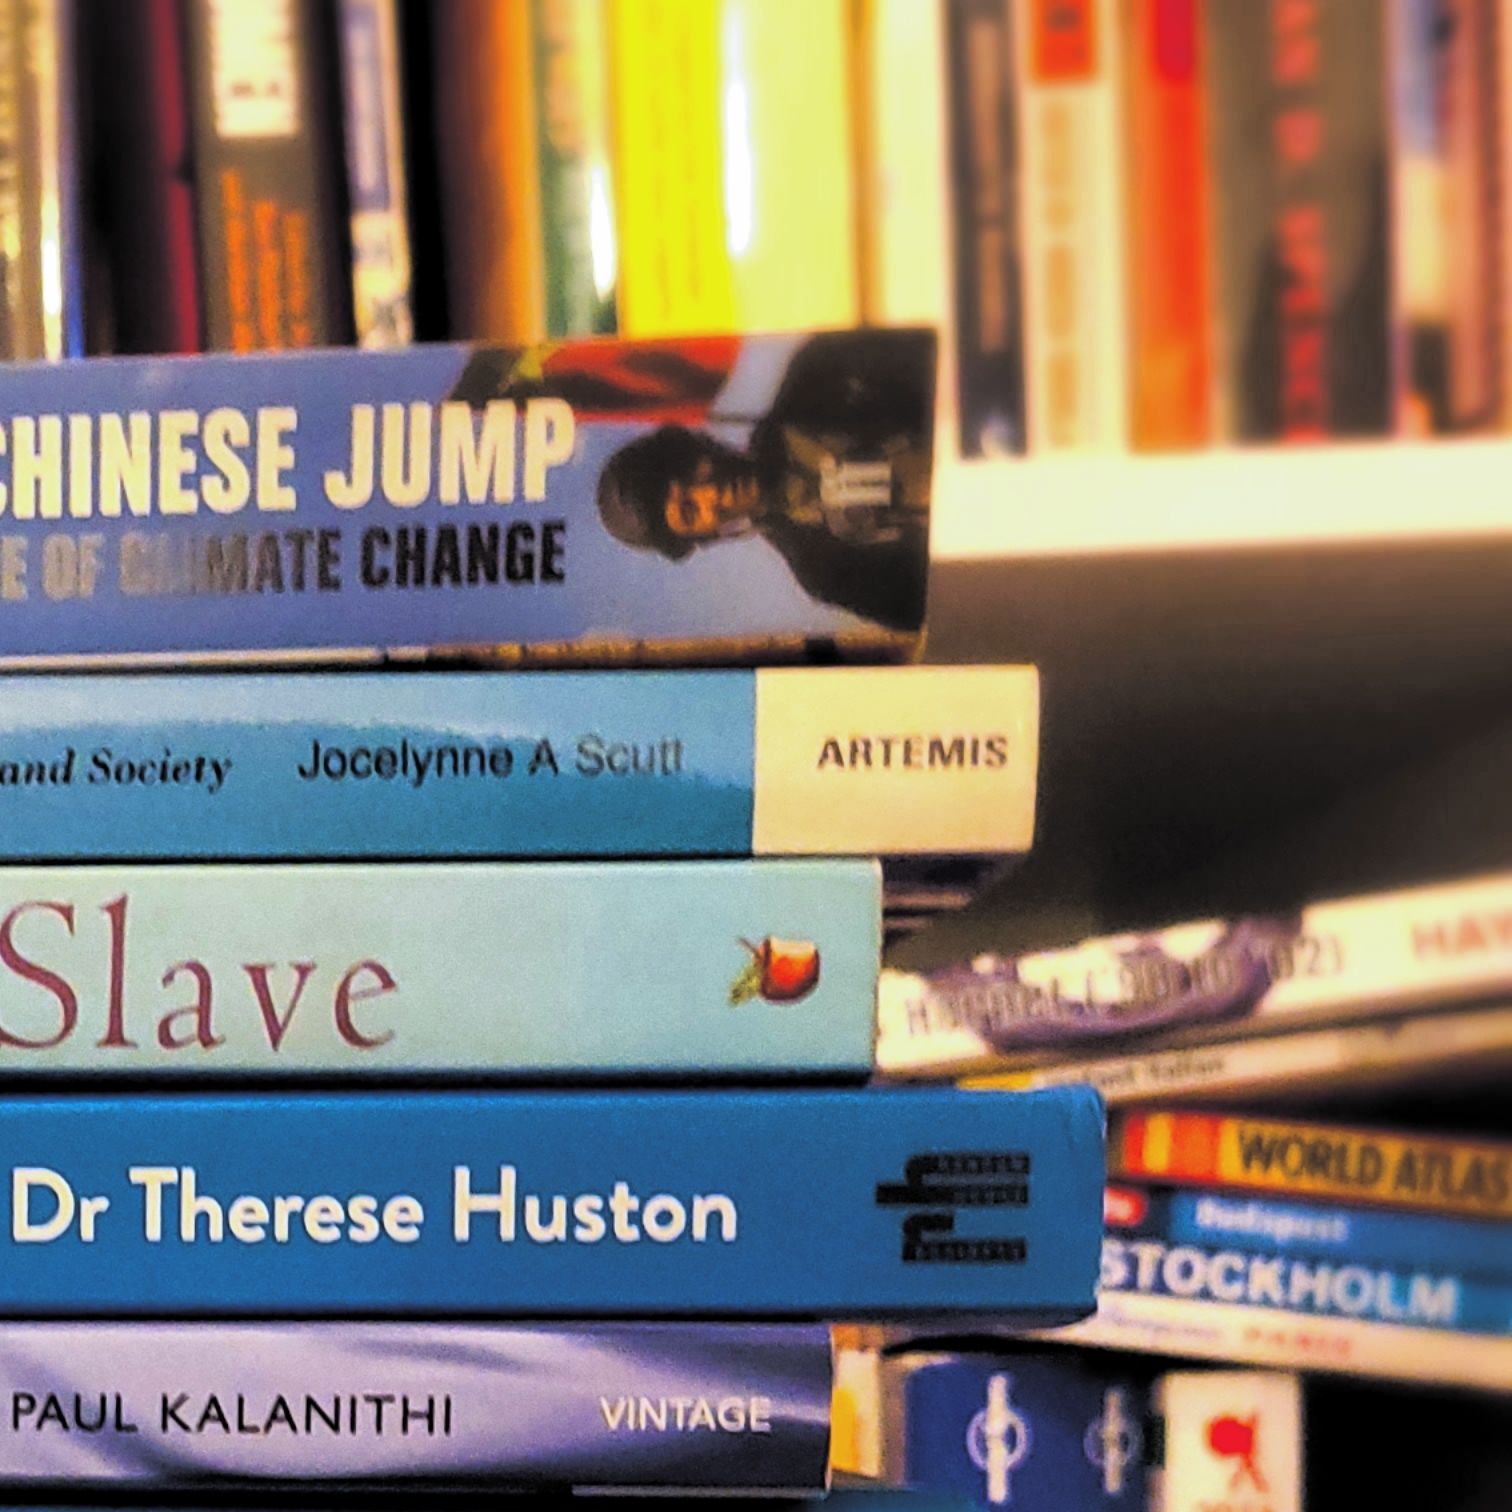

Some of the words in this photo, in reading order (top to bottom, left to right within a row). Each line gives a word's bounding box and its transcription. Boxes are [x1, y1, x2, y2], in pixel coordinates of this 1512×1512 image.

[324, 398, 575, 510] JUMP
[42, 532, 106, 598] OF
[359, 520, 566, 591] CHANGE
[88, 745, 234, 792] Society
[298, 738, 514, 790] Jocelynne
[528, 738, 560, 777] A
[576, 734, 684, 777] Scutt
[816, 736, 1010, 774] ARTEMIS
[1239, 1127, 1384, 1187] WORLD
[11, 1166, 109, 1243] Dr
[127, 1166, 425, 1244] Therese
[454, 1166, 739, 1244] Huston
[1100, 1240, 1460, 1322] STOCKHOLM
[12, 1392, 138, 1434] PAUL
[159, 1393, 454, 1437] KALANITHI
[599, 1396, 772, 1434] VINTAGE
